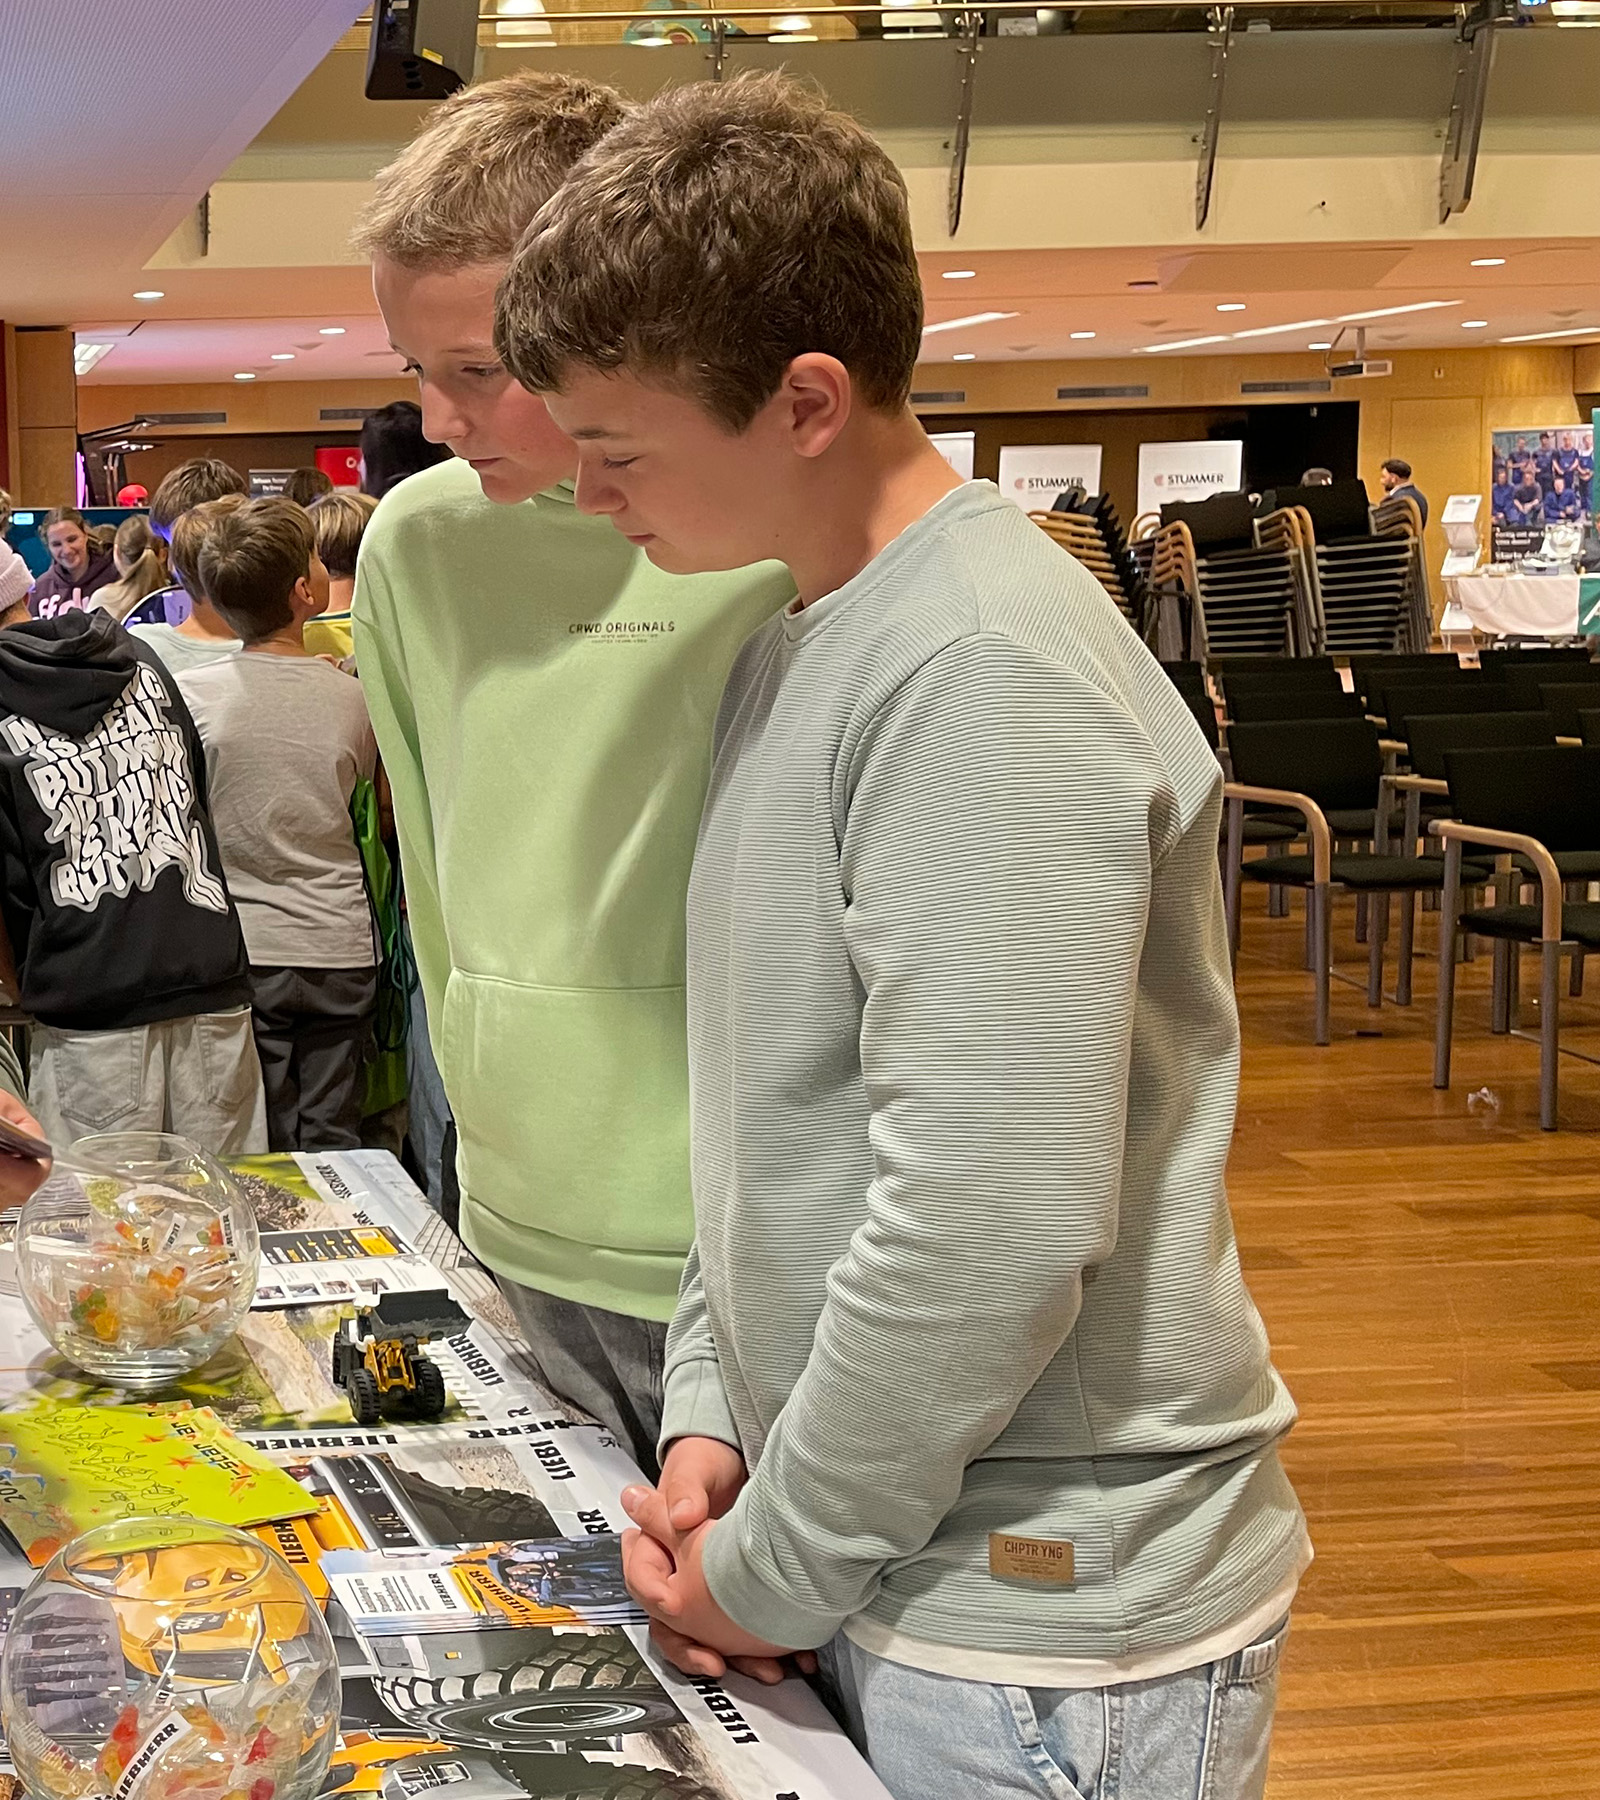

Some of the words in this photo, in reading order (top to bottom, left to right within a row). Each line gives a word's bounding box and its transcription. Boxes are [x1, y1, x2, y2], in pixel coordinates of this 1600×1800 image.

[1028, 477, 1083, 489] STUMMER
[1168, 474, 1224, 486] STUMMER
[568, 623, 602, 634] CRWD
[605, 621, 675, 633] ORIGINALS
[448, 1333, 505, 1386] LIEBHER
[248, 1434, 398, 1451] LIEBHER
[464, 1419, 570, 1439] HERR
[272, 1521, 311, 1564] LIEBH
[1004, 1541, 1039, 1557] CHPTR
[1041, 1545, 1063, 1559] YNG
[428, 1573, 457, 1609] LIEBHERR
[469, 1570, 531, 1614] LIEBHERR
[686, 1676, 760, 1744] LIEBH
[115, 1723, 179, 1800] LIEBHERR
